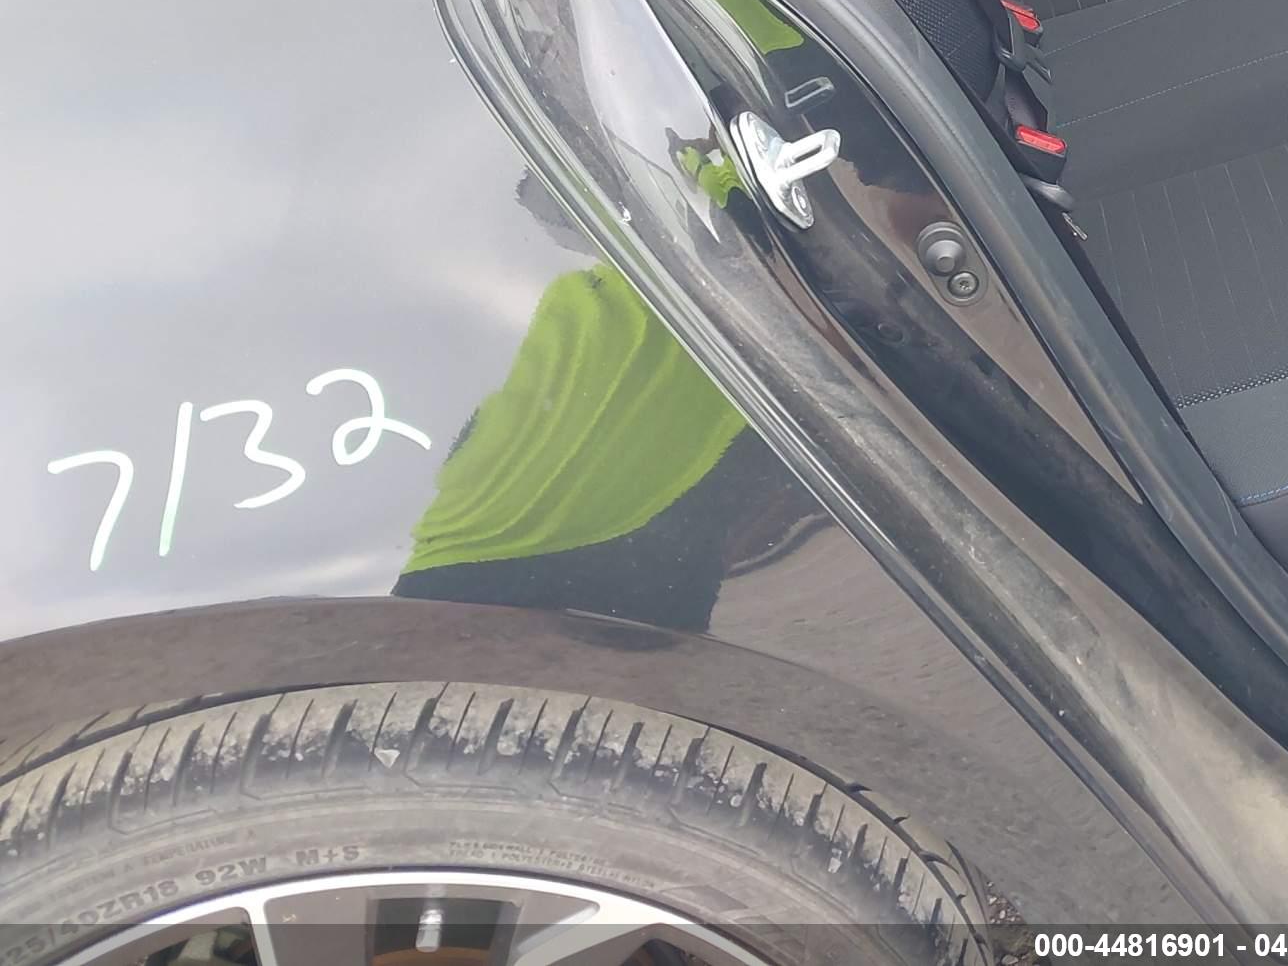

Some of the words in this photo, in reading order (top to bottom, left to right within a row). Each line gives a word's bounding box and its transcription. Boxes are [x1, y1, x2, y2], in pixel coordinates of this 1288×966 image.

[47, 368, 432, 571] 7132
[0, 876, 180, 966] 25/40ZR18
[194, 856, 267, 886] 92W
[295, 845, 361, 867] M+S
